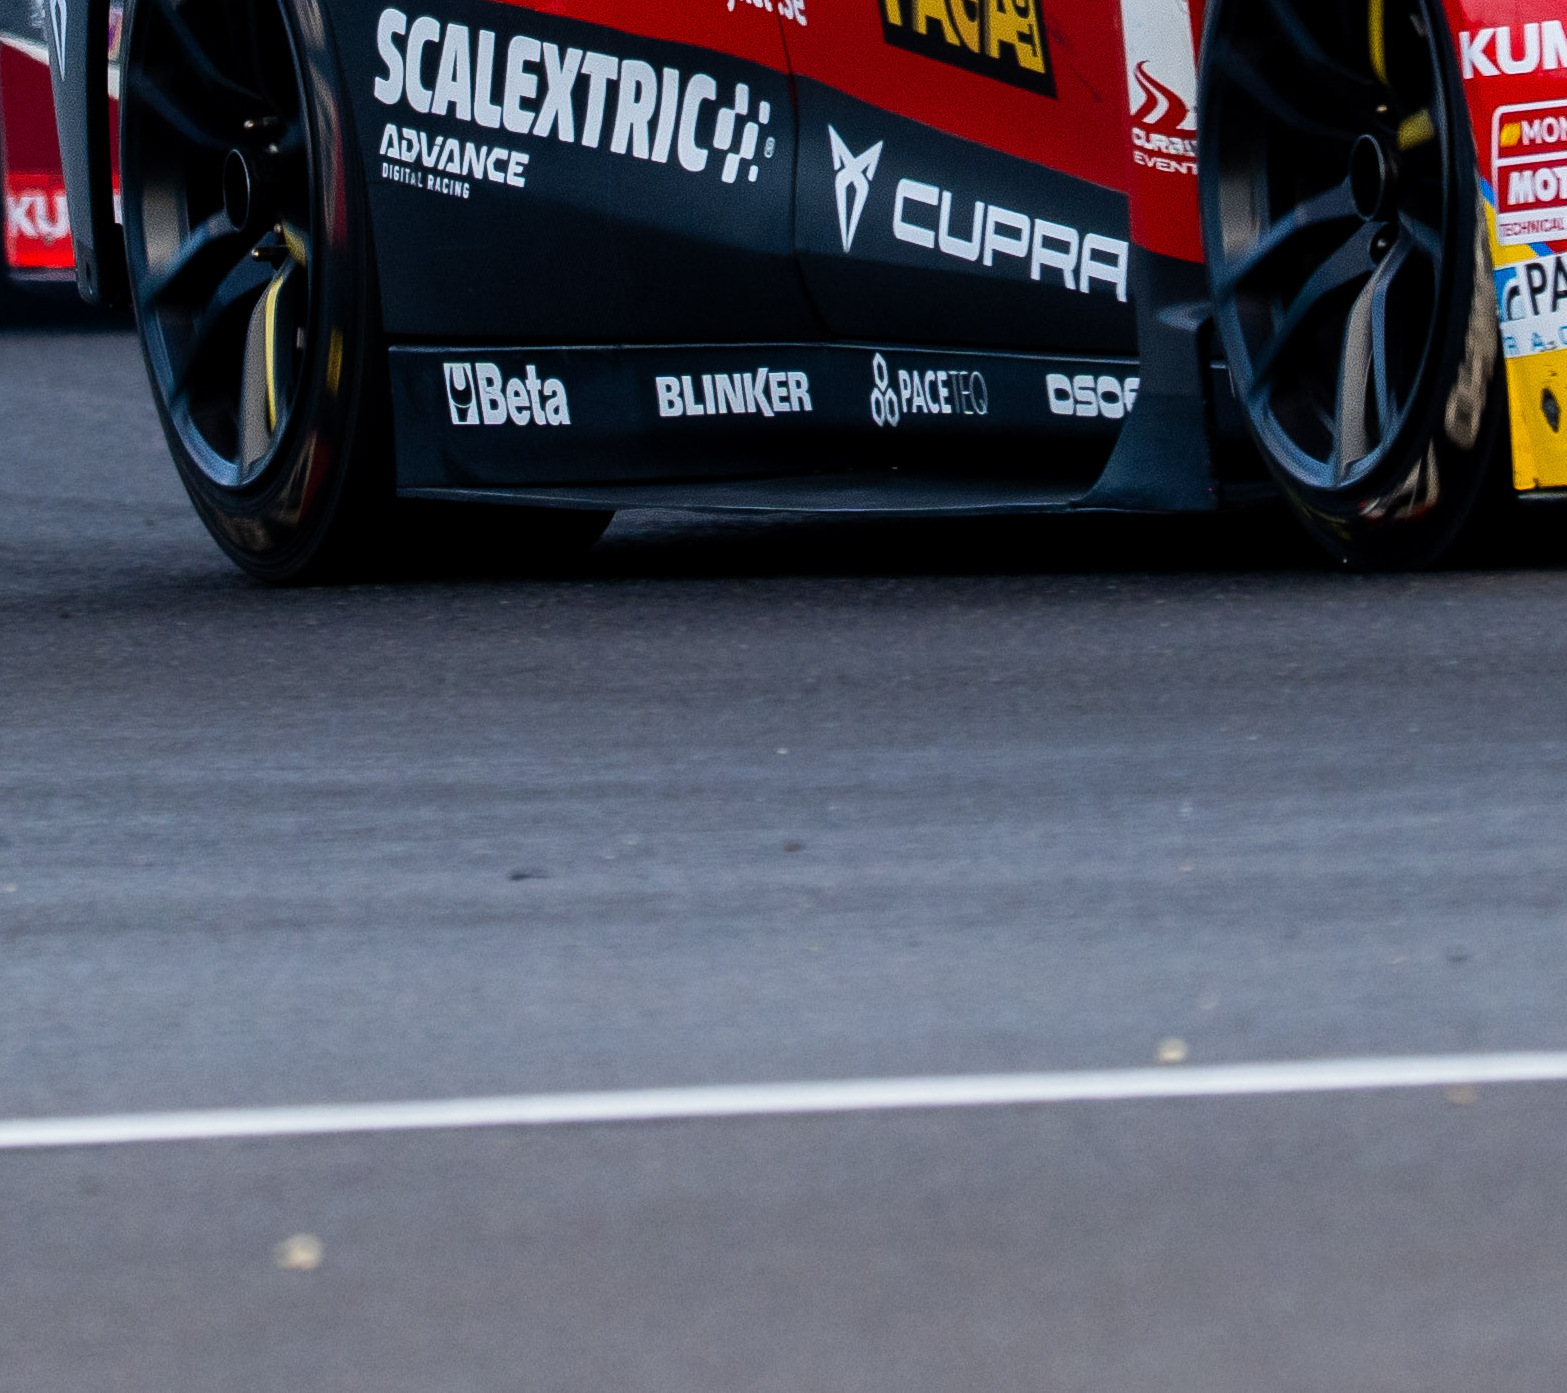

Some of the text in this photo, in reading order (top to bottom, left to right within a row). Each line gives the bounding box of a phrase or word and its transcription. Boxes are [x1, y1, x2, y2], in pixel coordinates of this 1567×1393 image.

[374, 8, 717, 171] SCALEXTRIC
[380, 123, 530, 188] ADVANCE
[382, 162, 470, 199] DIGITAL RACING
[892, 177, 1130, 303] CUPRA
[1499, 217, 1564, 238] TECHNICAL
[476, 362, 571, 426] Beta
[655, 367, 813, 418] BLINKER
